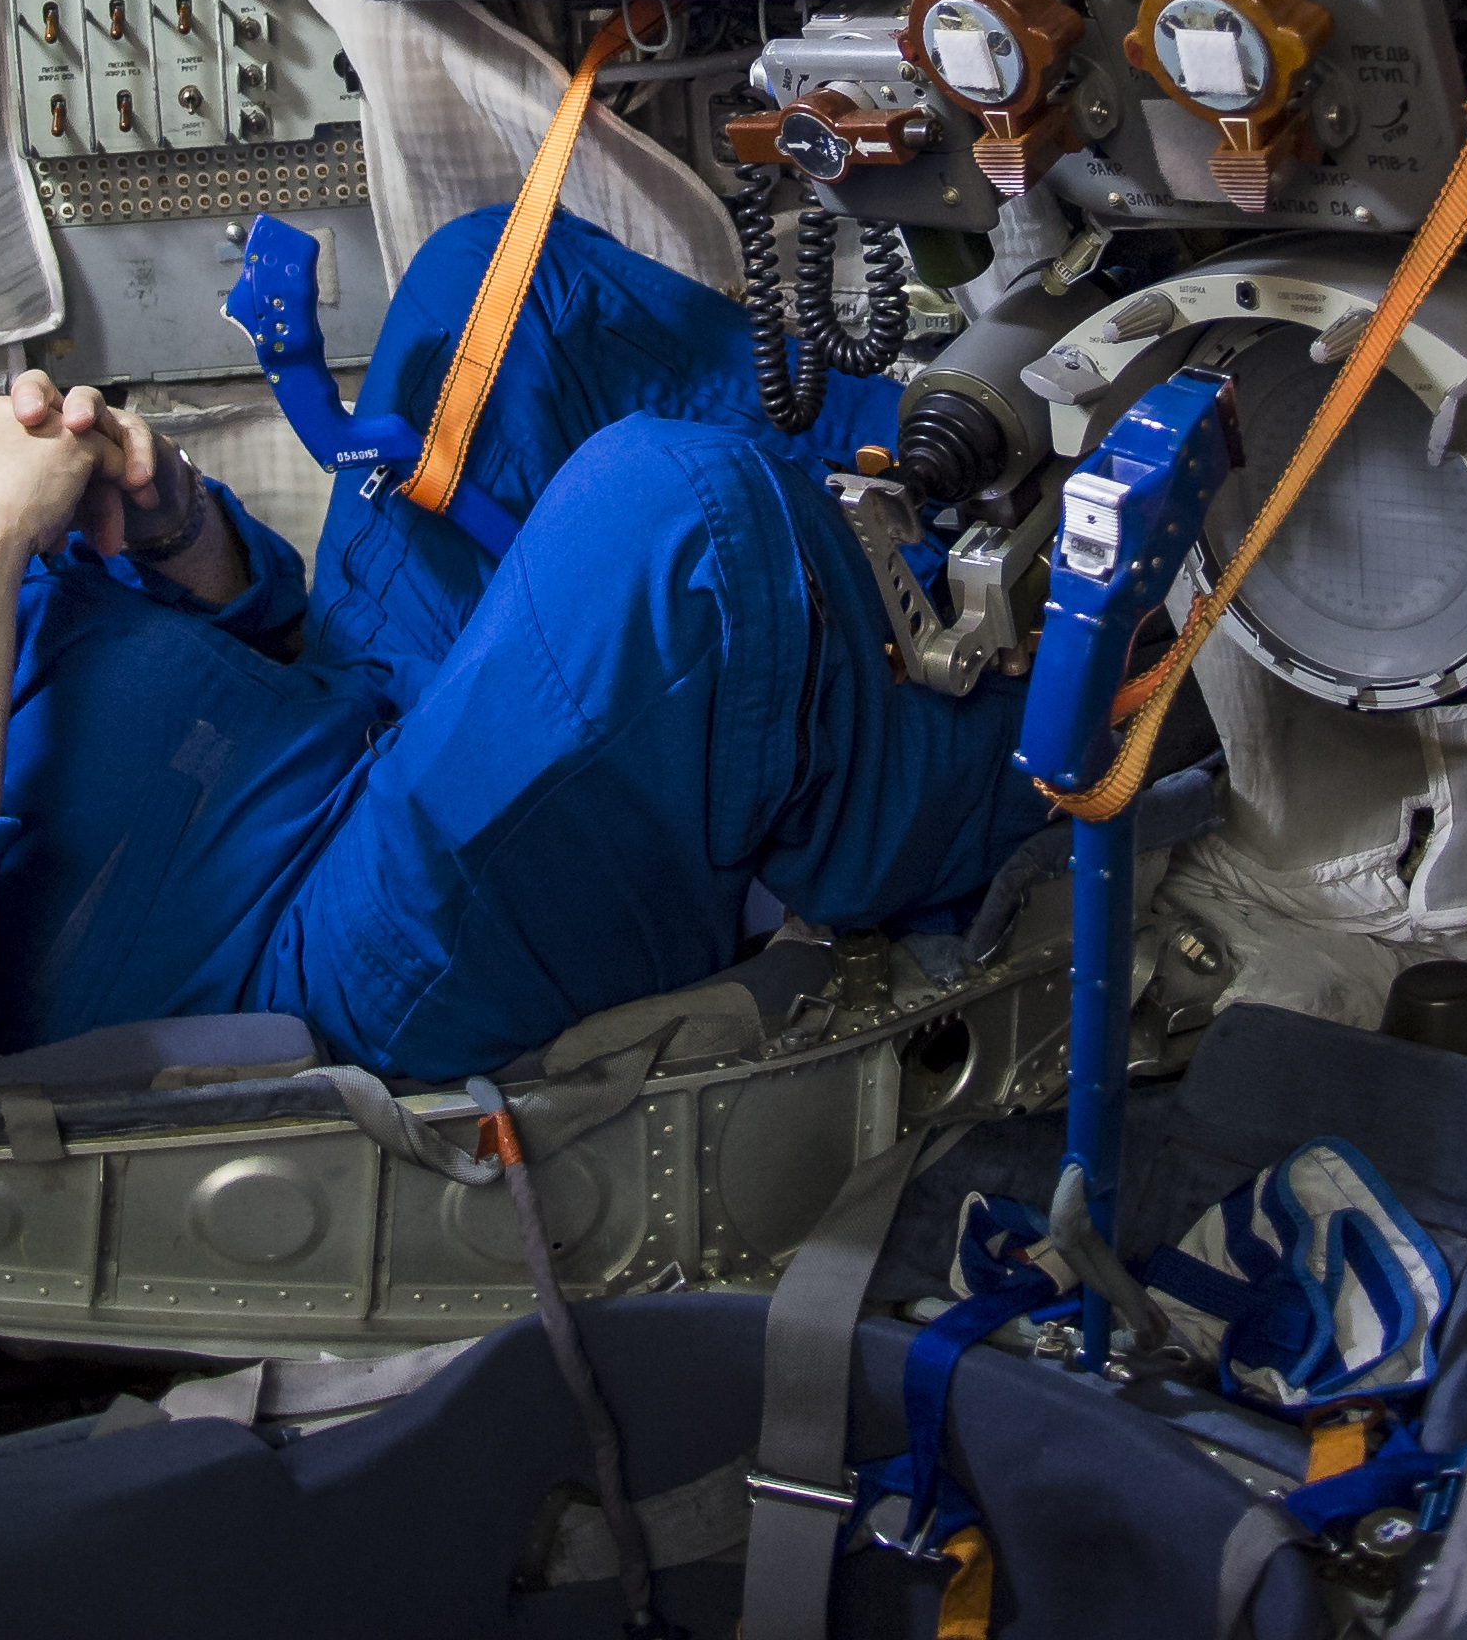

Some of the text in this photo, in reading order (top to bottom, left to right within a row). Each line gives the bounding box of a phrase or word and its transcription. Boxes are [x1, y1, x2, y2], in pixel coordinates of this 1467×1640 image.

[1087, 163, 1125, 177] ЗАКР.
[1368, 156, 1419, 173] РПВ-2
[1126, 192, 1174, 208] ЗАПАС
